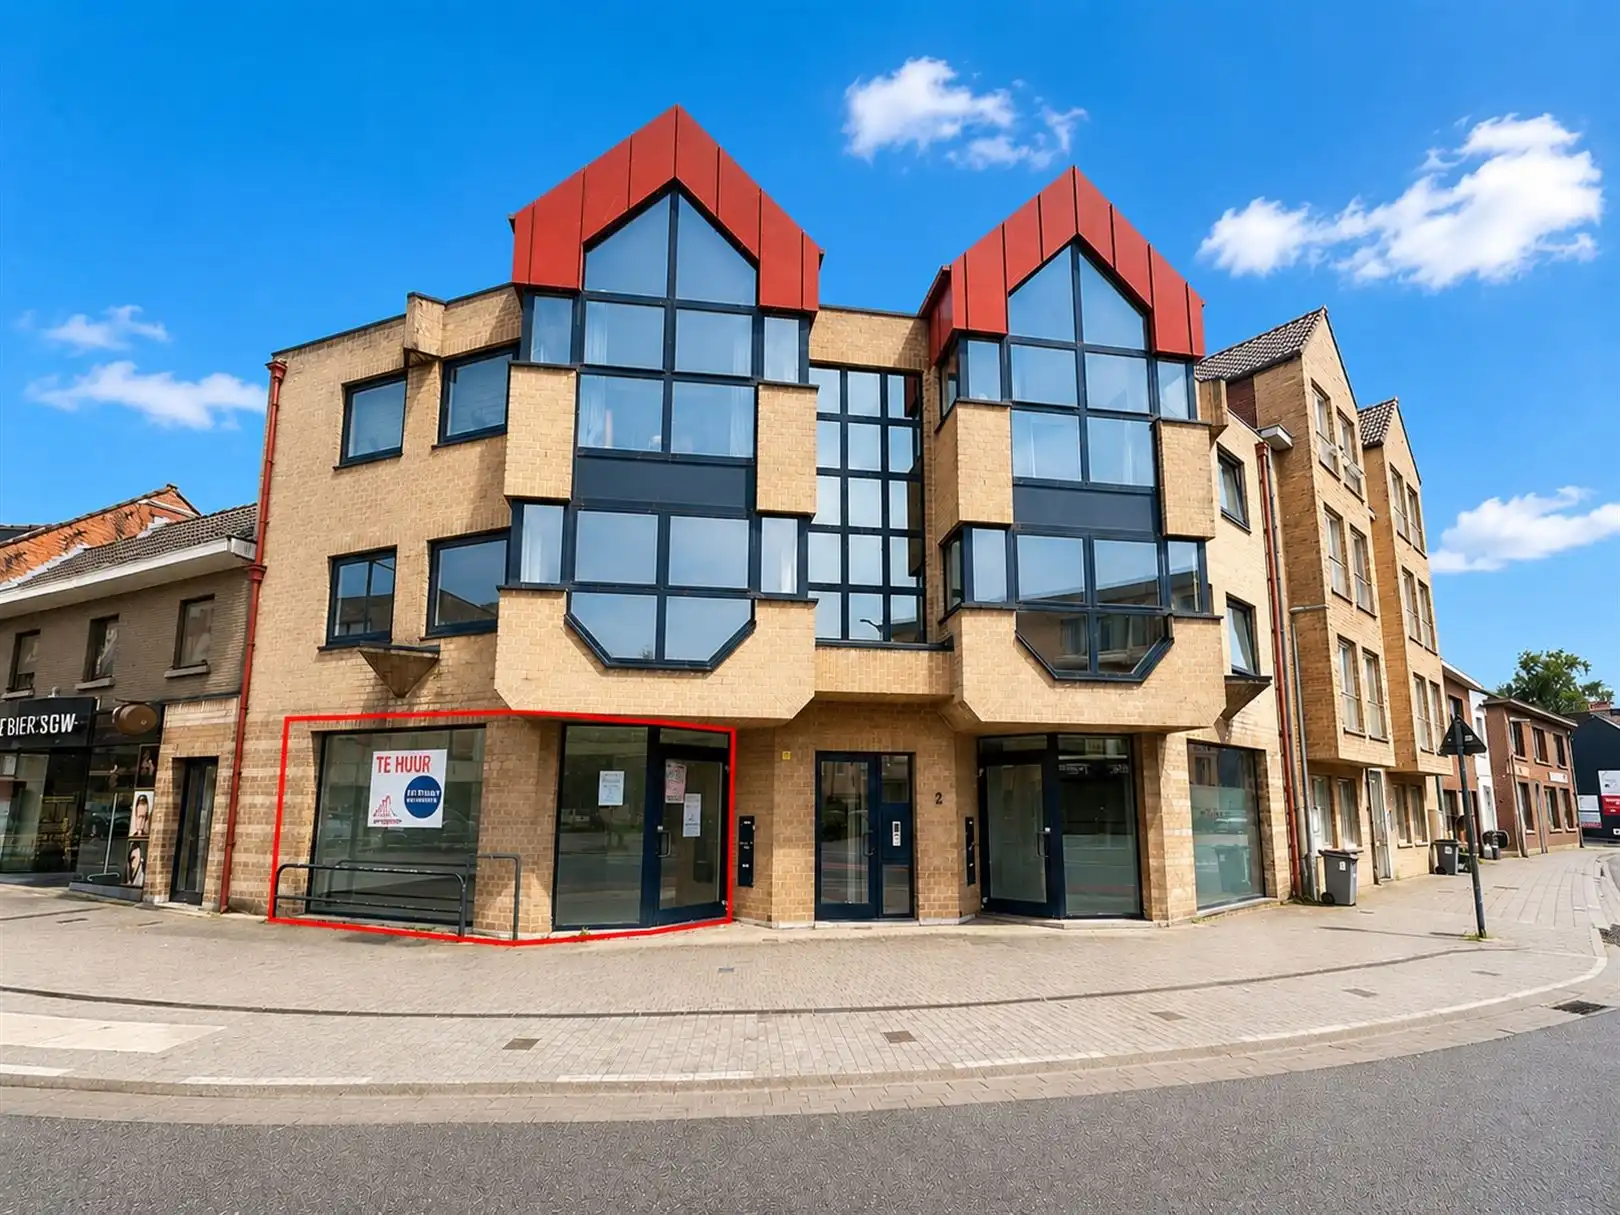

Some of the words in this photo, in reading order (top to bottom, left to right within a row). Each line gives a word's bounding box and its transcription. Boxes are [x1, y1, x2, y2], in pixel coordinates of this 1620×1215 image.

[376, 755, 391, 773] TE
[395, 755, 431, 773] HUUR
[935, 791, 943, 805] 2
